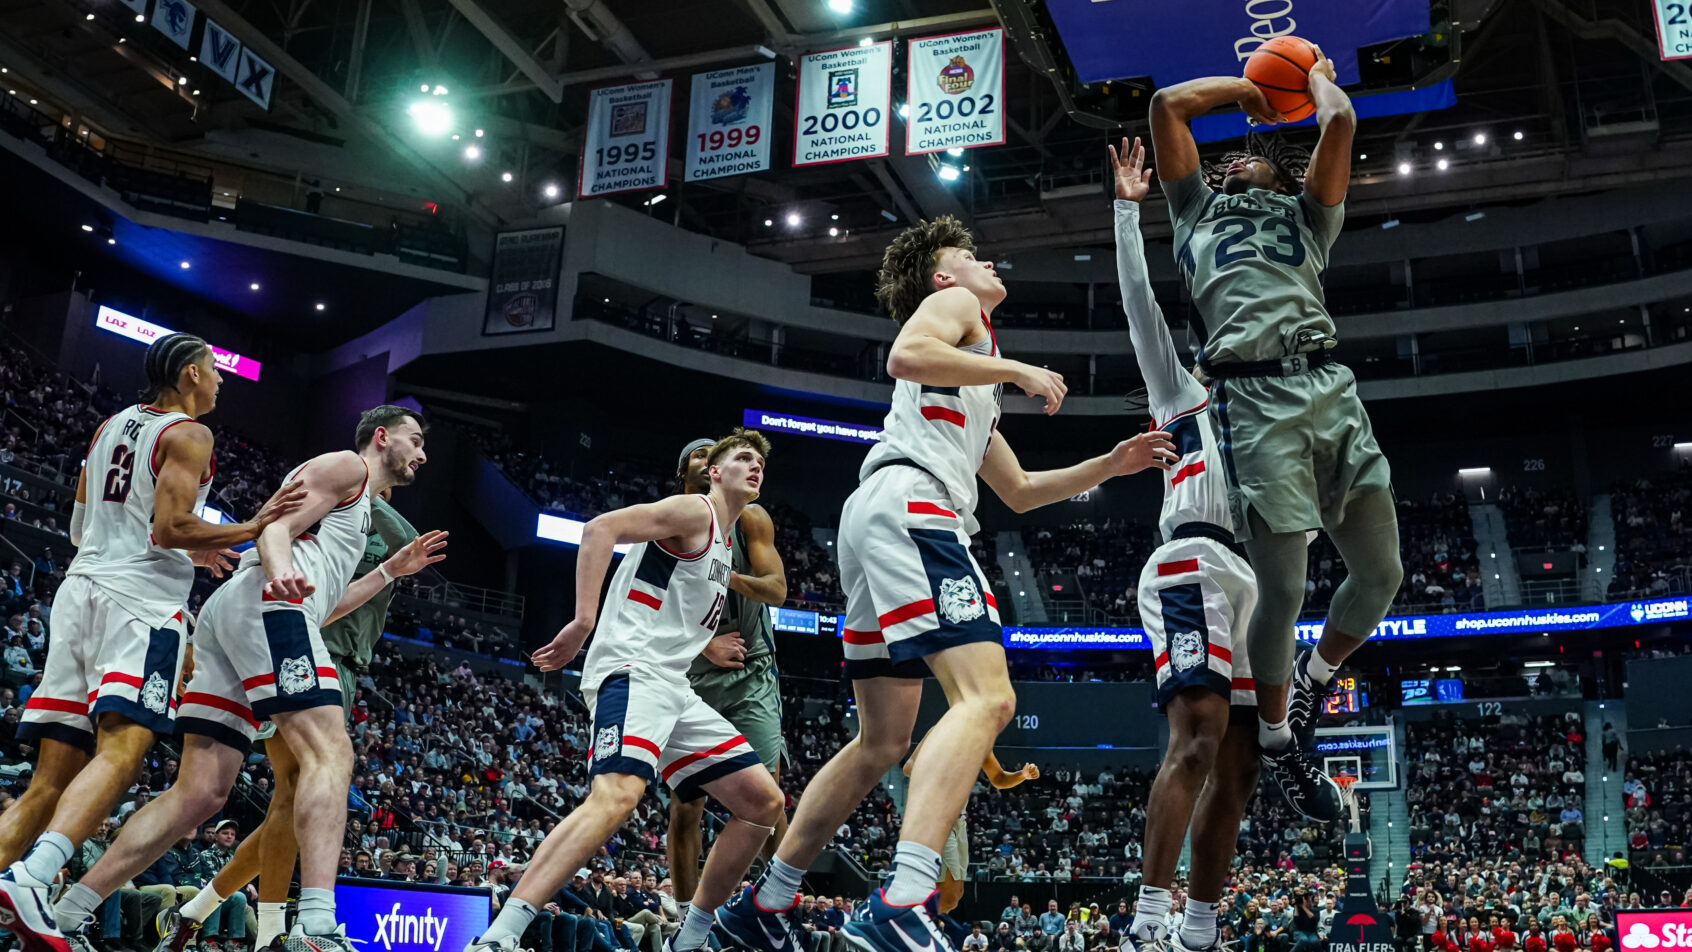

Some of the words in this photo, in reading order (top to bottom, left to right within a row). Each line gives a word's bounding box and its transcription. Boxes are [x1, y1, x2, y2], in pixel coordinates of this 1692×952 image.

[1667, 3, 1692, 25] 2
[919, 39, 950, 49] UConn
[951, 31, 994, 44] Women's
[808, 53, 838, 63] UConn
[840, 46, 882, 58] Women's
[933, 43, 981, 56] Basketball
[821, 57, 868, 70] Basketball
[706, 70, 734, 80] UConn
[711, 76, 755, 89] Basketball
[597, 87, 624, 97] UConn
[609, 92, 652, 104] Basketball
[917, 94, 995, 123] 2002
[802, 107, 881, 136] 2000
[924, 120, 987, 135] NATIONAL
[697, 125, 761, 152] 1999
[810, 132, 871, 148] NATIONAL
[919, 132, 992, 149] CHAMPIONS
[596, 141, 656, 168] 1995
[699, 149, 757, 165] NATIONAL
[805, 144, 876, 161] CHAMPIONS
[596, 166, 652, 180] NATIONAL
[693, 161, 761, 178] CHAMPIONS
[591, 176, 656, 193] CHAMPIONS
[1213, 196, 1297, 223] BUTER
[1212, 215, 1306, 269] 23
[1290, 357, 1302, 373] B
[761, 415, 788, 427] Don't
[787, 418, 816, 431] forget
[816, 423, 835, 434] you
[835, 425, 857, 438] have
[1652, 435, 1674, 447] 227
[1523, 459, 1545, 471] 226
[700, 591, 725, 632] 12
[1644, 600, 1688, 615] UCONN
[820, 615, 837, 625] 10:43
[1455, 612, 1600, 630] shop.uconnhuskies.com
[1010, 631, 1143, 644] shop.uconnhuskies.com
[1327, 692, 1354, 714] 21
[1477, 702, 1502, 717] 122
[373, 902, 448, 952] xfinity
